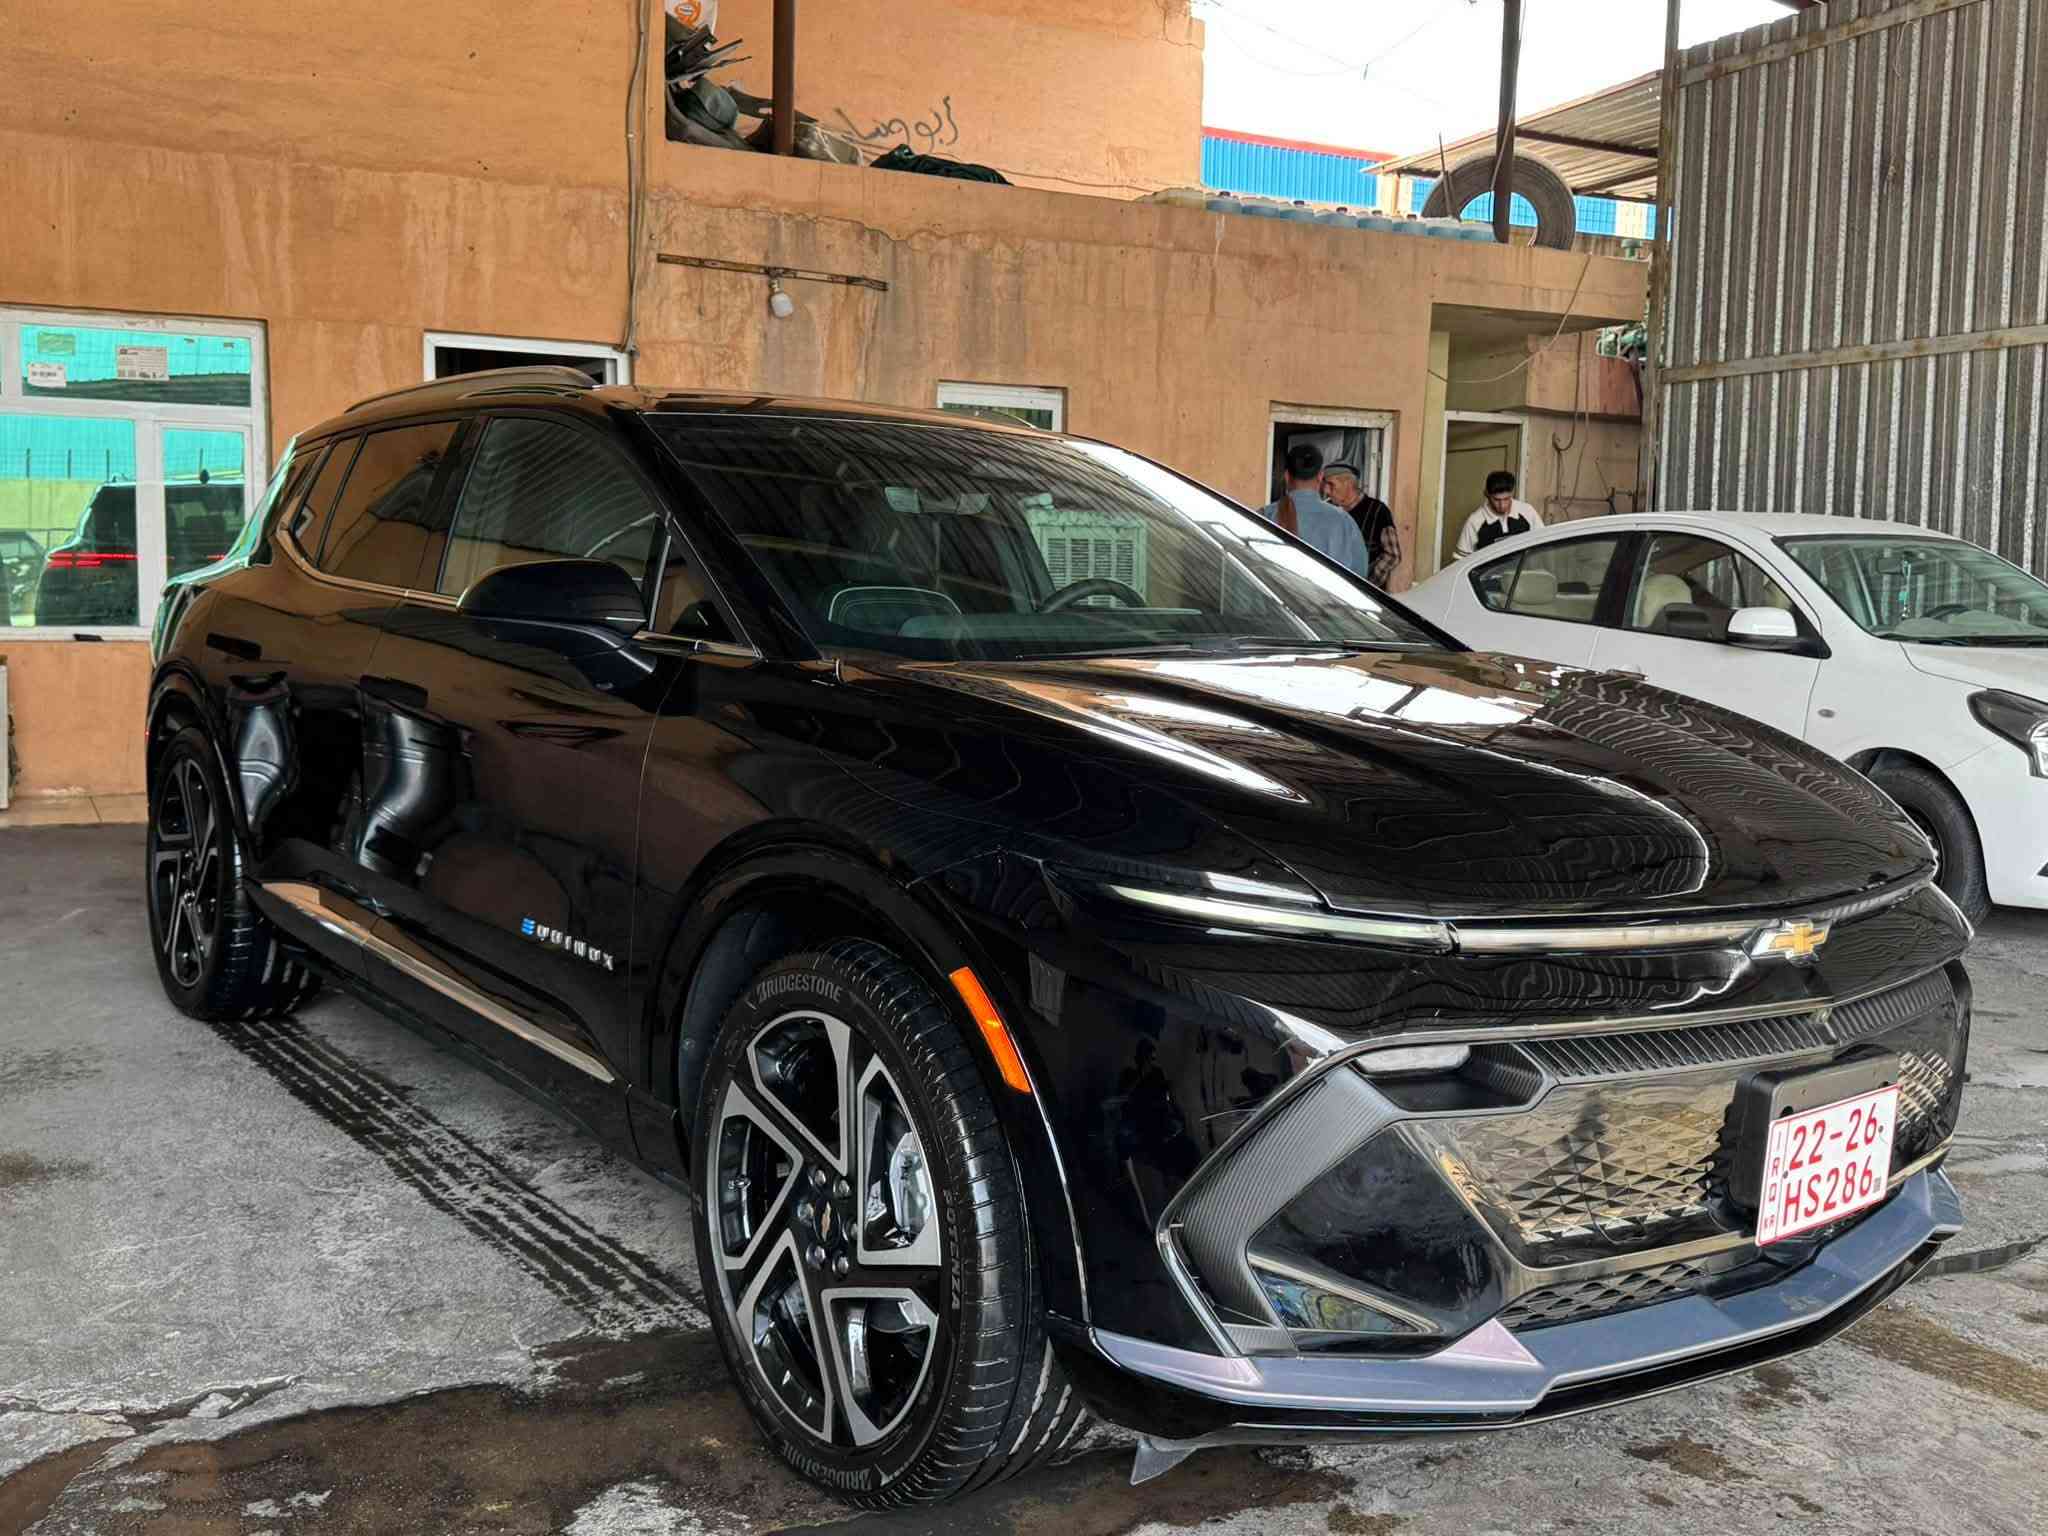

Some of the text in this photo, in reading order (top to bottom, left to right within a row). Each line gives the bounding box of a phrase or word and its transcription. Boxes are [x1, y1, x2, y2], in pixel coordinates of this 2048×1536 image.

[756, 974, 842, 1004] BRIDGESTONE
[1789, 1102, 1877, 1170] 22-26
[1783, 1154, 1873, 1227] HS286
[943, 1188, 961, 1310] POTENZA
[783, 1440, 872, 1491] BRIDGESTONE
